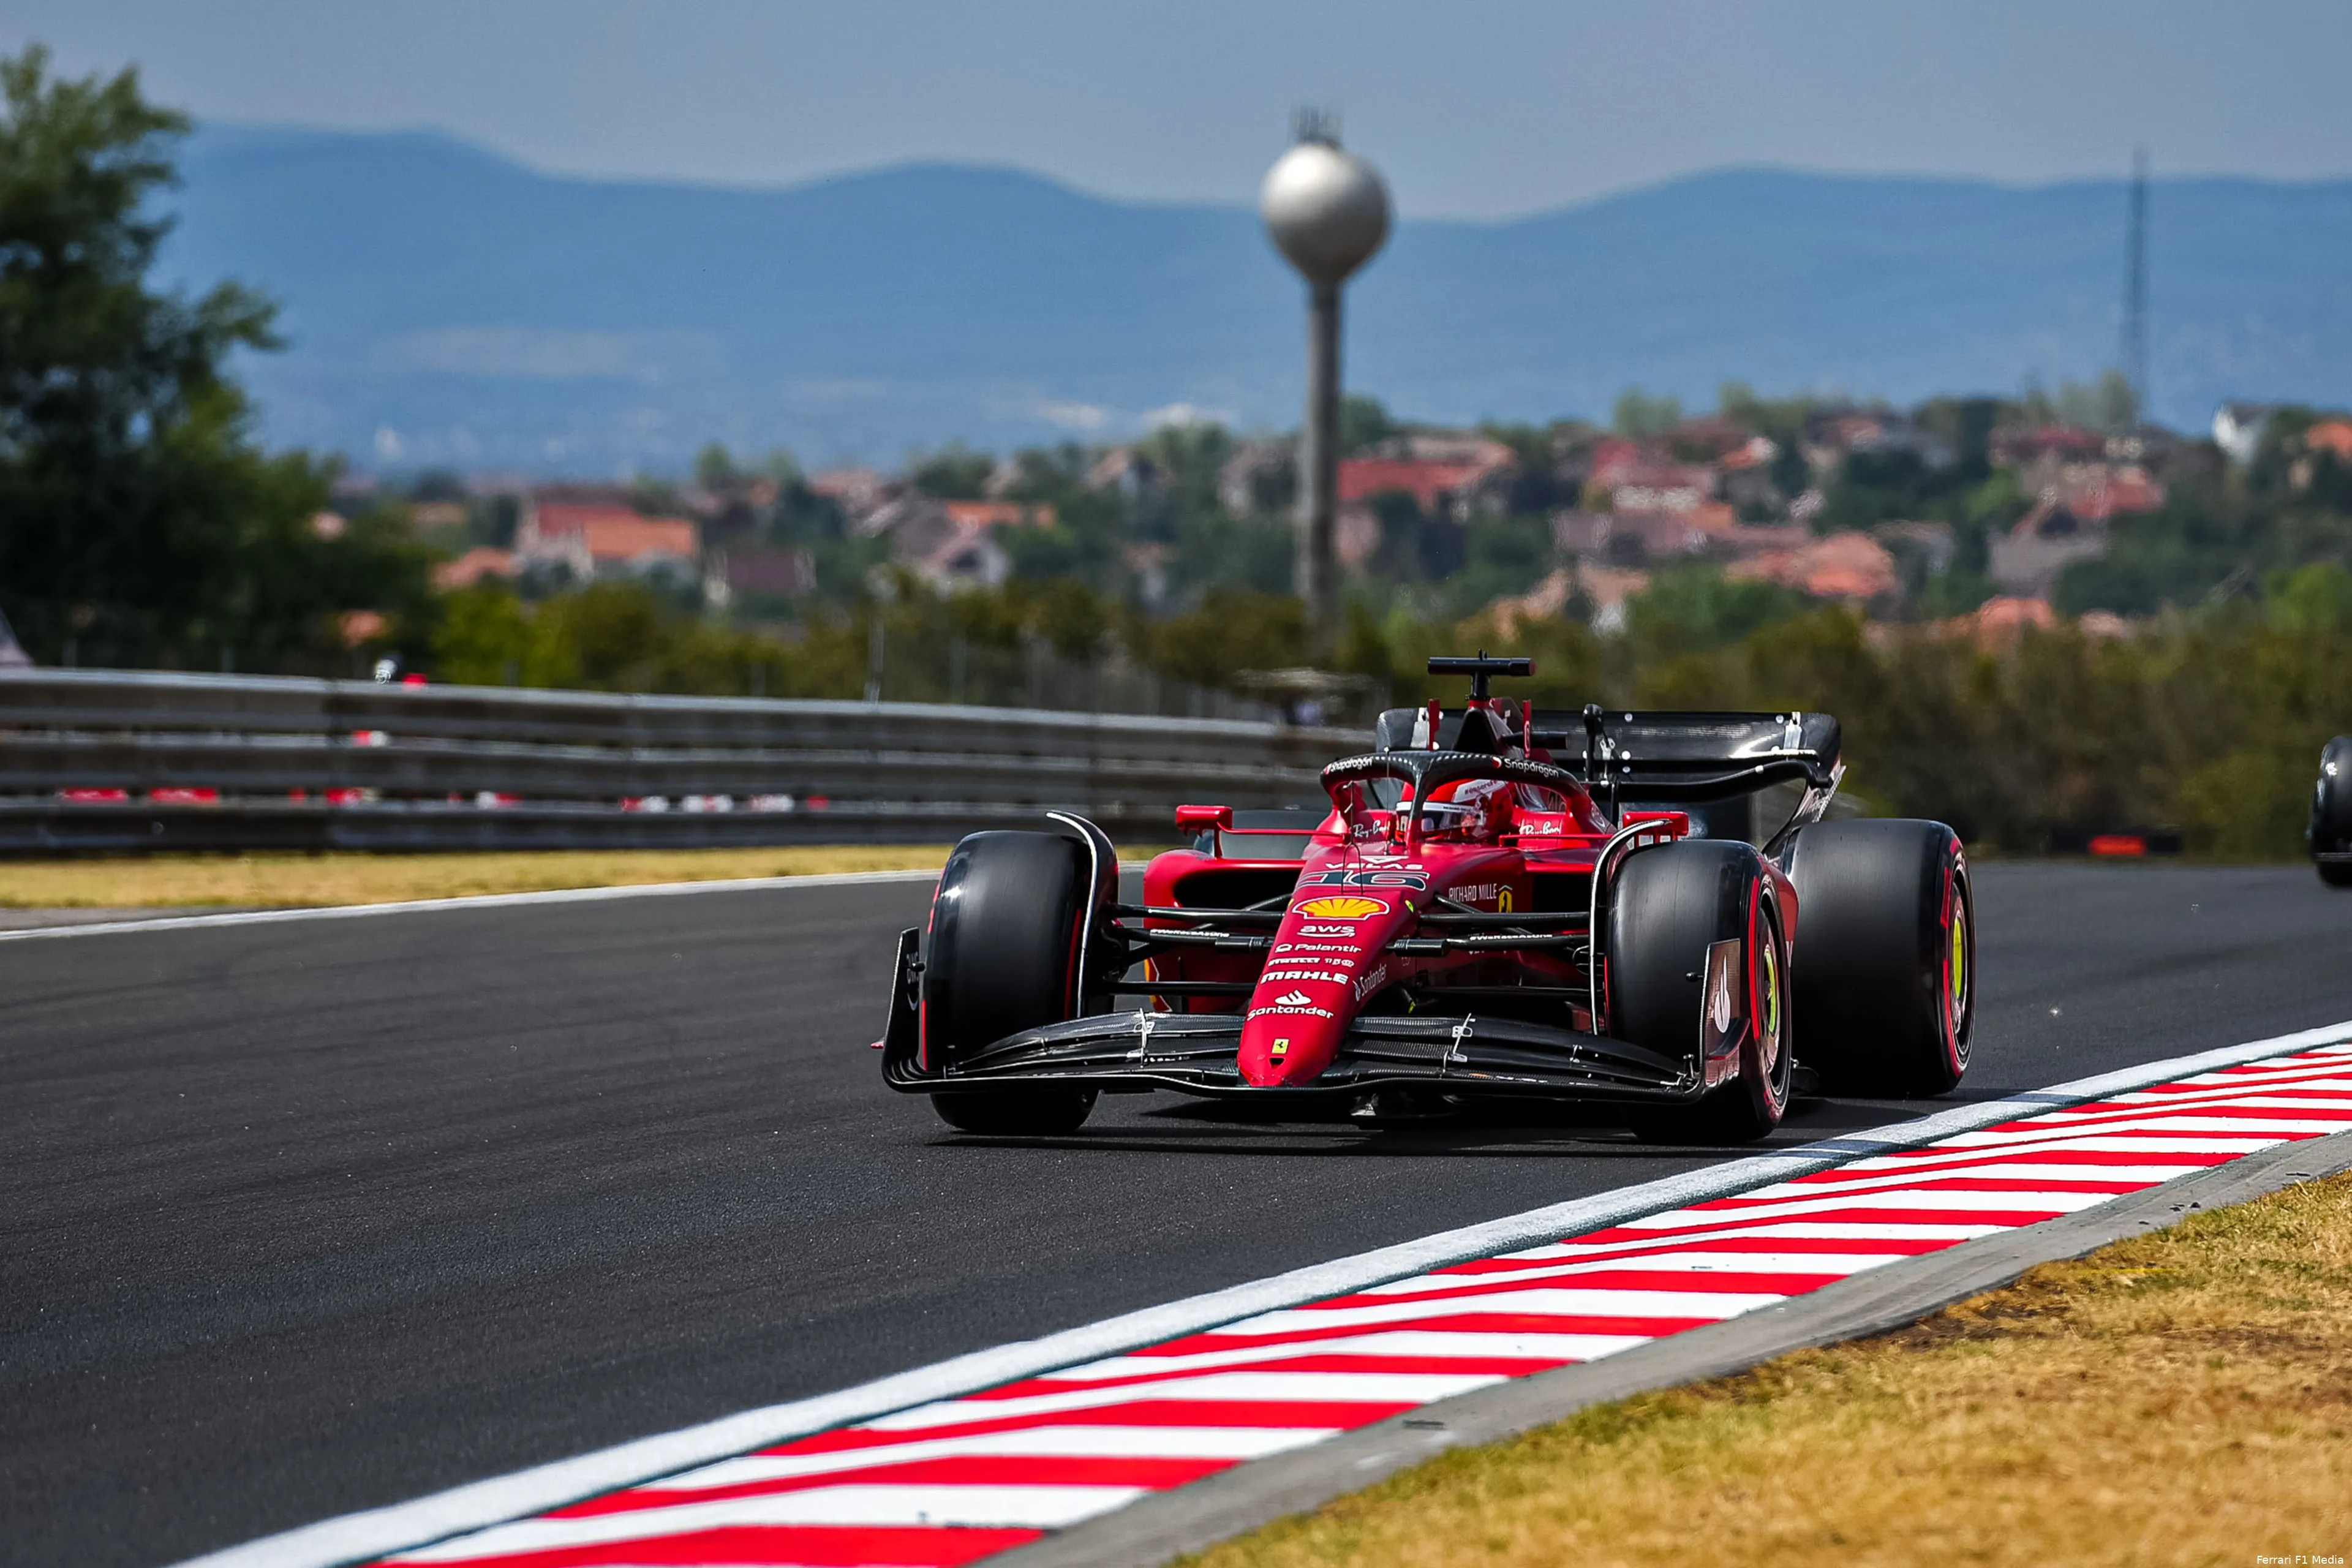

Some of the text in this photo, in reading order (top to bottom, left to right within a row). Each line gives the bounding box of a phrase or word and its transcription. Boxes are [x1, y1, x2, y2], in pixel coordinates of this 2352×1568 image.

[1330, 755, 1374, 772] Snapdragon
[1504, 758, 1559, 778] Snapdragon
[1296, 869, 1431, 891] 16
[1448, 883, 1498, 902] RICHARD MILLE
[1299, 925, 1356, 934] aws
[1294, 943, 1362, 954] Palantir
[1260, 970, 1349, 986] MAHLE
[1360, 963, 1387, 997] Santander
[1246, 1006, 1334, 1022] Santander
